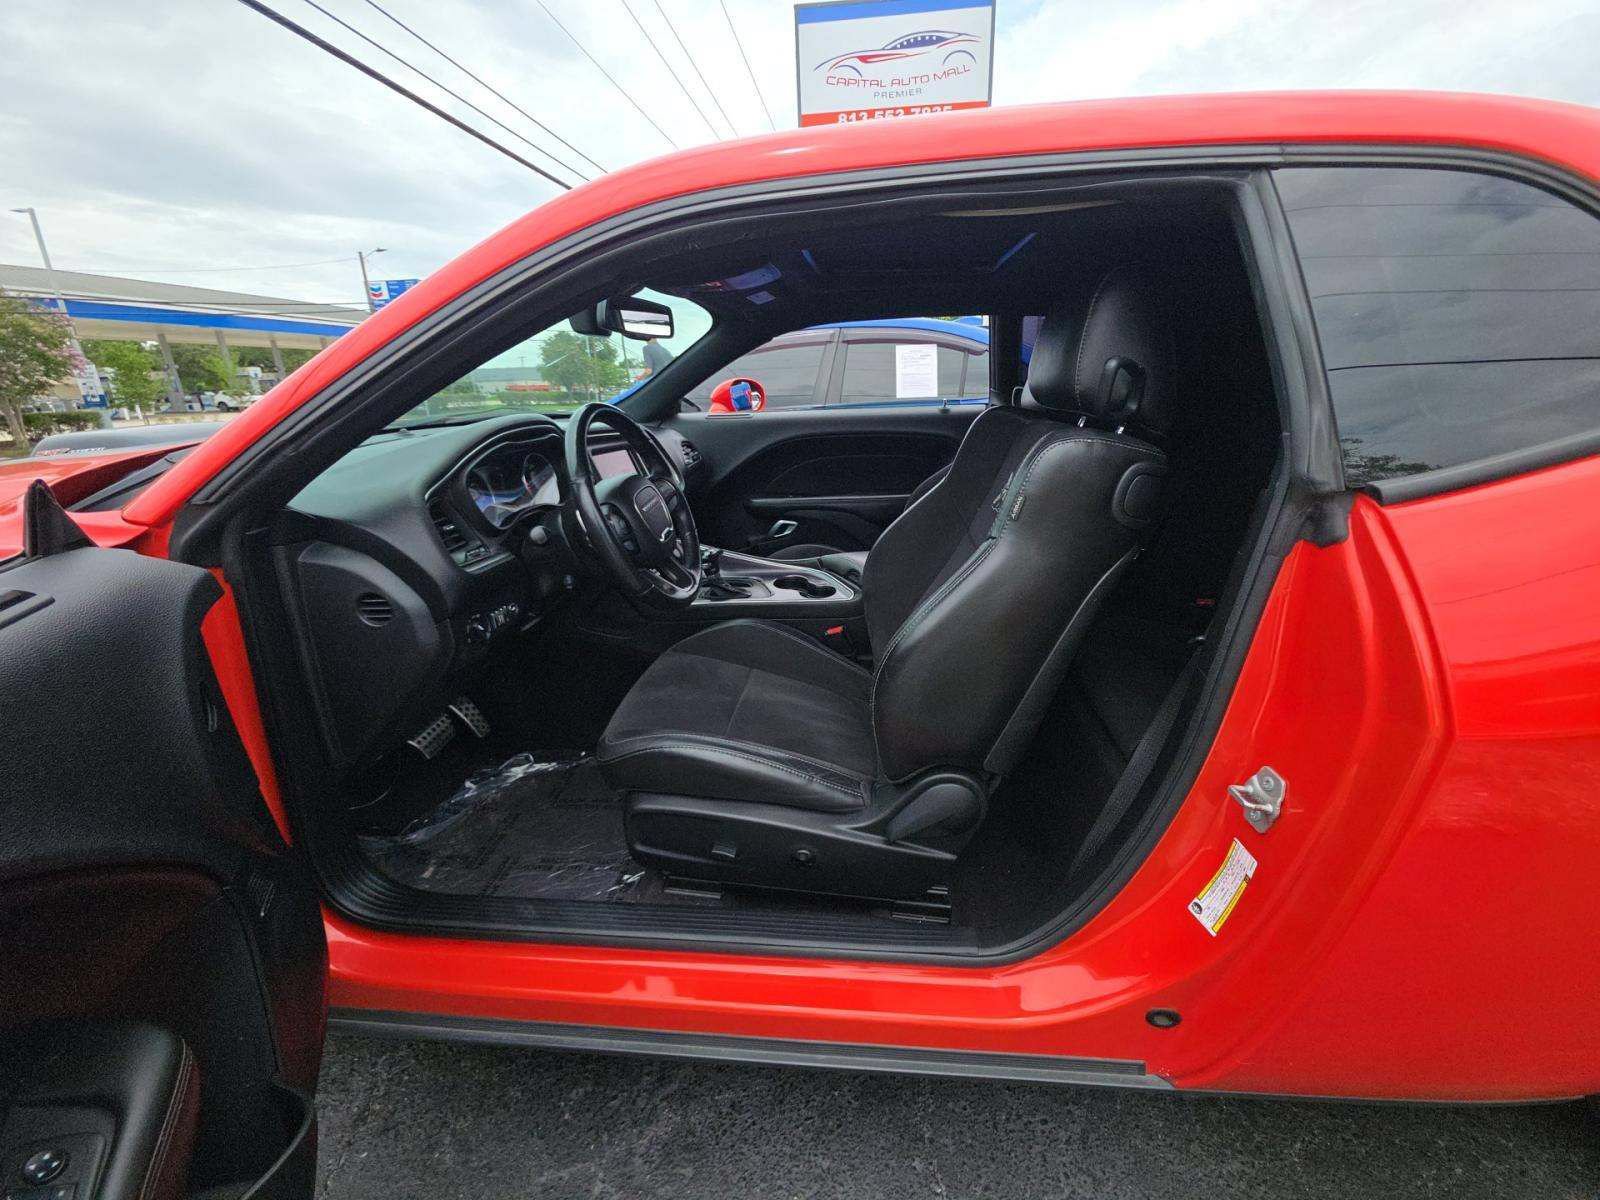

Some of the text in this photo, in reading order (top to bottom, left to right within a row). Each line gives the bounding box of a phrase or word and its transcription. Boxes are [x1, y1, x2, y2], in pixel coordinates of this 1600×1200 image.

[826, 65, 971, 88] CAPITAL AUTO MALL
[873, 87, 922, 100] PREMIER
